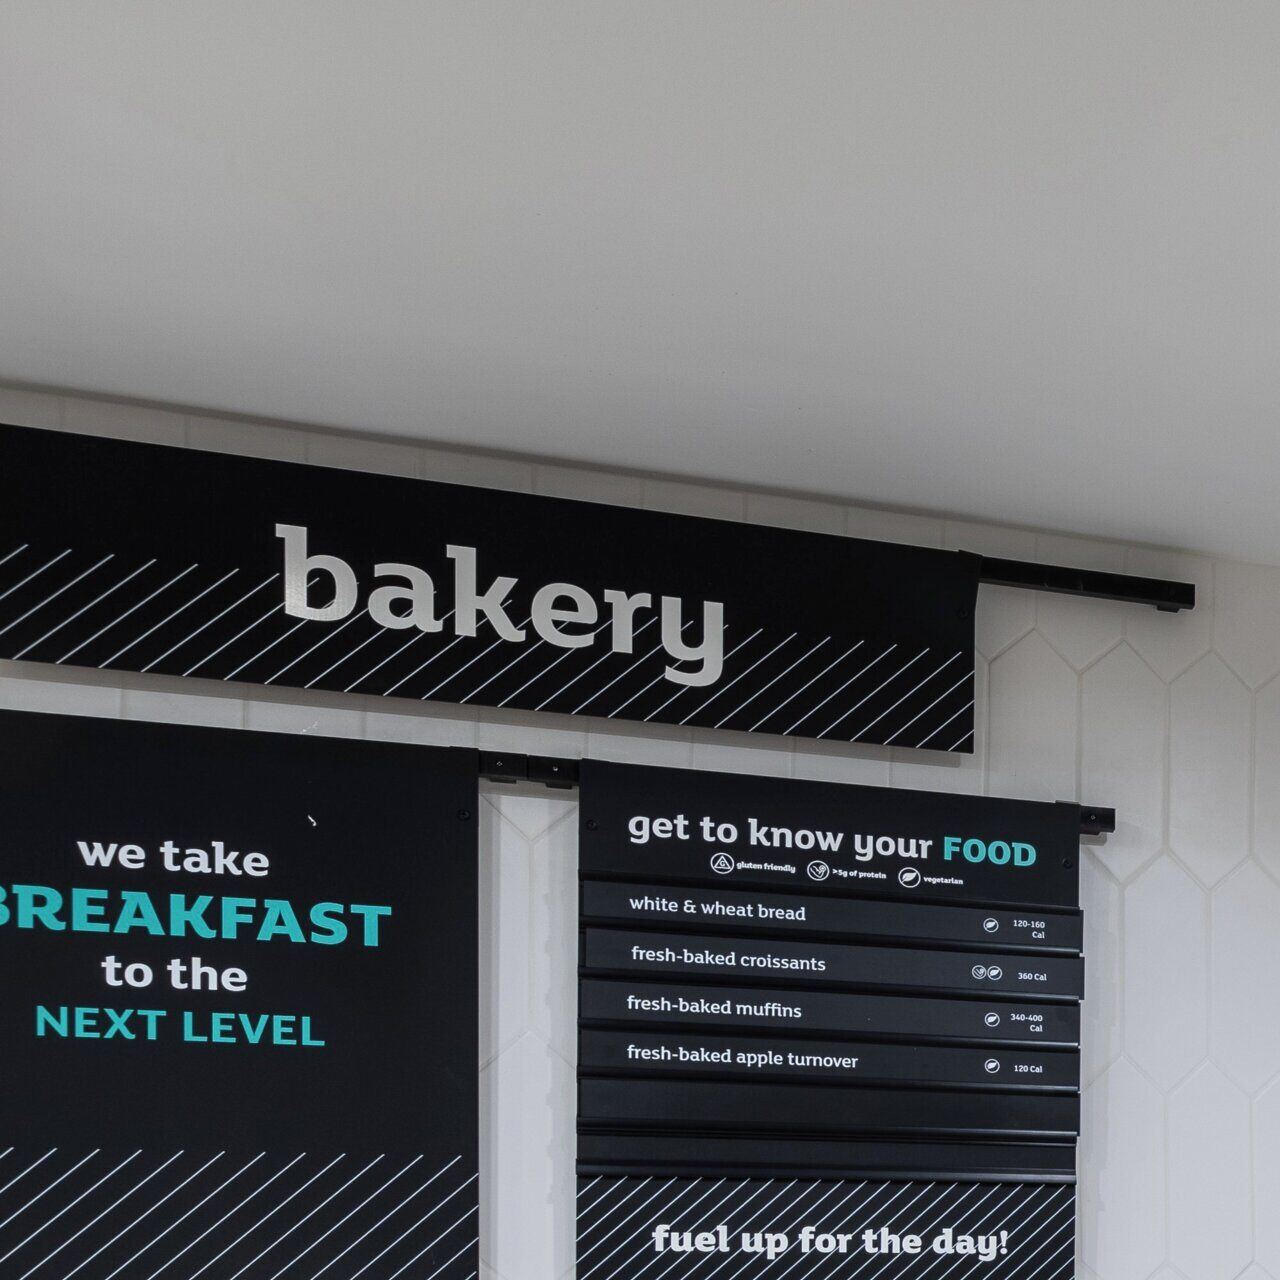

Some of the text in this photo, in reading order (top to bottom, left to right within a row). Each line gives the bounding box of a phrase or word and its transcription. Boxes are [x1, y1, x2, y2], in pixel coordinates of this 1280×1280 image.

[275, 523, 726, 688] bakery
[629, 815, 1036, 866] get to know your FOOD
[77, 841, 269, 876] we take
[736, 860, 796, 874] gluten friendly
[832, 868, 848, 878] >5g
[858, 871, 887, 879] protein
[923, 876, 964, 885] vegetarian
[0, 885, 391, 946] REAKFAST
[629, 895, 807, 921] white & wheat bread
[1013, 919, 1046, 929] 120-160
[1031, 930, 1045, 939] Cal
[631, 945, 826, 971] fresh-baked croissants
[101, 956, 247, 991] to the
[1017, 972, 1047, 981] 360 Cal
[626, 994, 802, 1018] fresh-baked muffins
[1010, 1013, 1043, 1022] 340-400
[37, 1006, 325, 1046] NEXT LEVEL
[1029, 1024, 1043, 1032] Cal
[626, 1044, 859, 1068] fresh-baked apple turnover
[1014, 1064, 1043, 1073] 120 Cal
[651, 1225, 1010, 1262] fuel up for the day!
